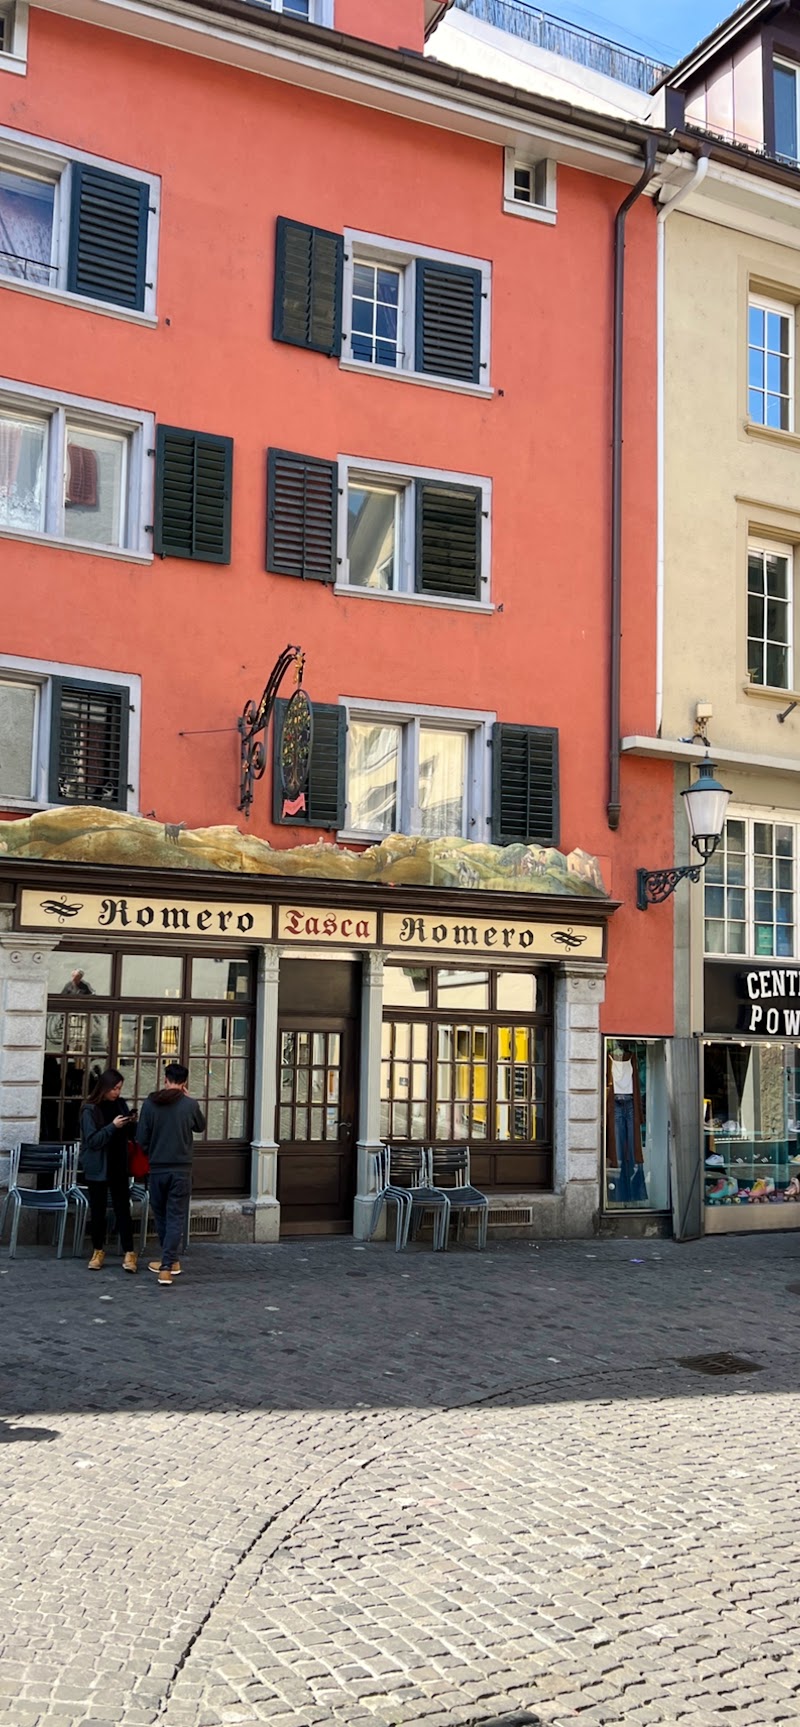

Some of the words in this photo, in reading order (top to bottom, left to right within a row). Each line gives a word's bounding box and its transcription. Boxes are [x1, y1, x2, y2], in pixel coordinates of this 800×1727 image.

[98, 898, 255, 933] Romero
[284, 909, 371, 939] Tasca
[399, 916, 535, 949] Romero
[746, 970, 800, 1000] CENT
